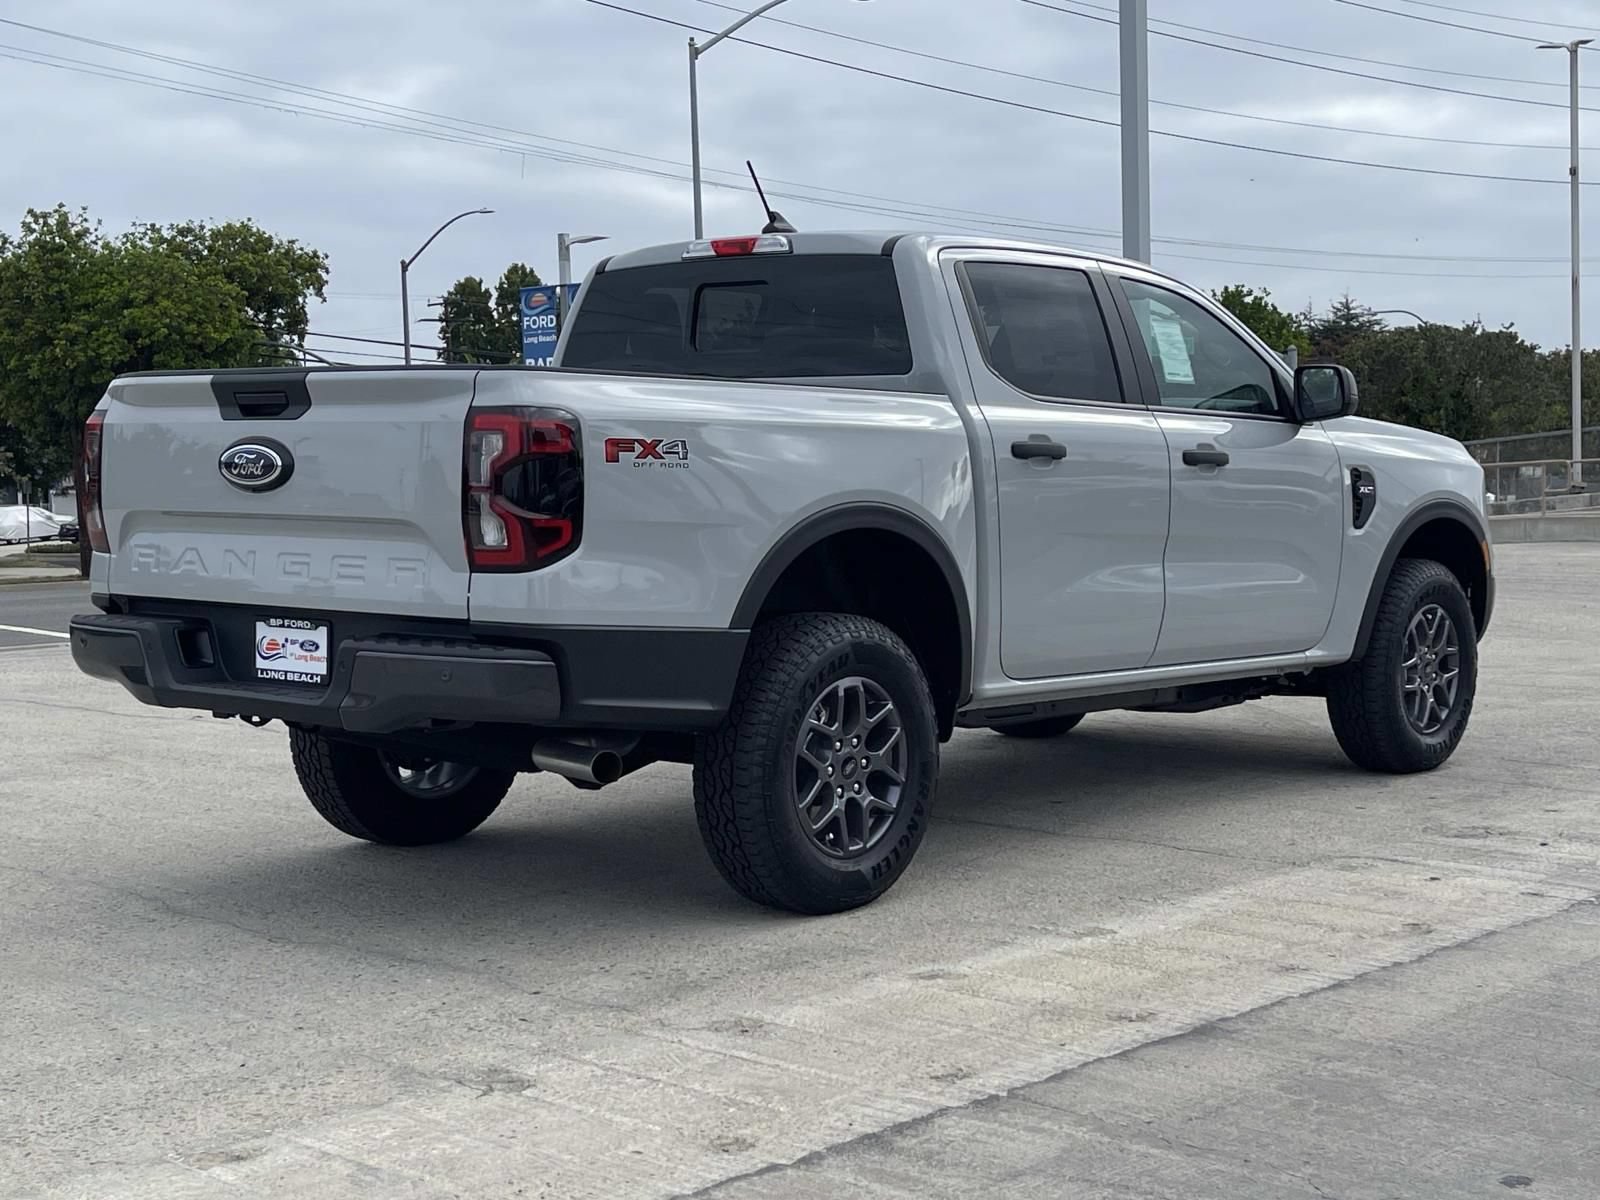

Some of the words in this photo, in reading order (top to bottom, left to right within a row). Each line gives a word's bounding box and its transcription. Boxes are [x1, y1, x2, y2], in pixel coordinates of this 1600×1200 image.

[523, 315, 556, 329] FORD
[524, 336, 538, 344] Long
[539, 334, 557, 342] Beach
[604, 437, 689, 464] FX4
[231, 452, 265, 476] Ford
[131, 543, 426, 589] RANGER
[285, 620, 311, 628] FORD
[258, 670, 285, 680] LONG
[287, 673, 321, 683] BEACH
